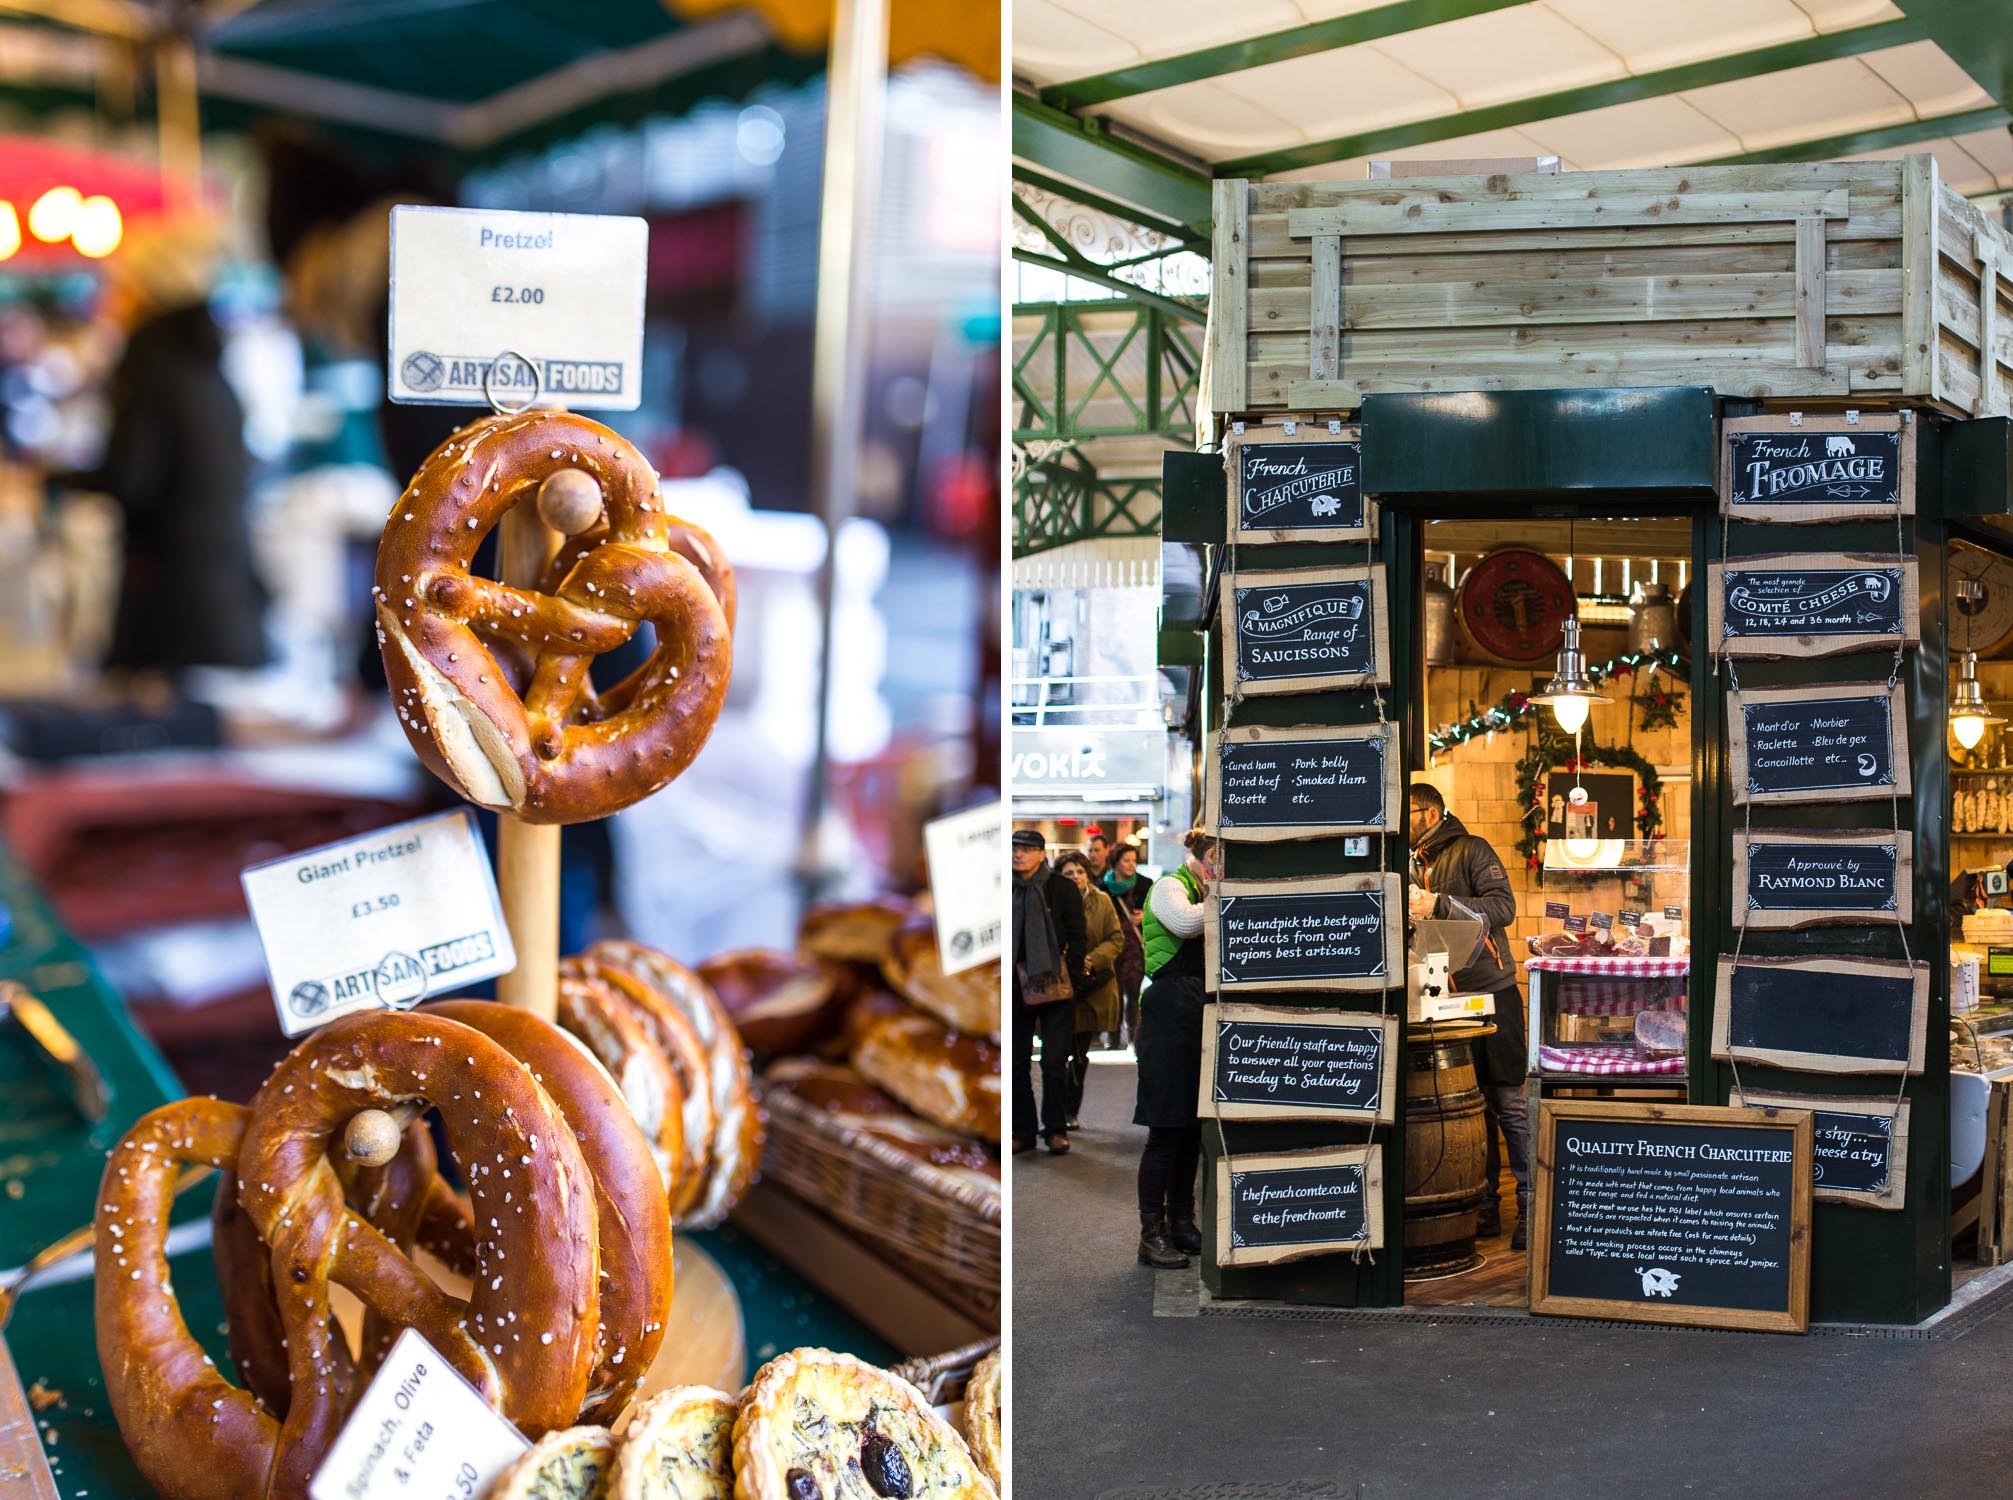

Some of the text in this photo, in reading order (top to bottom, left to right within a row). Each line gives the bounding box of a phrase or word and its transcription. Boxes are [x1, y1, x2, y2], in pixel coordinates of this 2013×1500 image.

[481, 226, 552, 249] Pretzel
[491, 286, 544, 305] £2.00
[549, 365, 620, 391] FOODS
[1752, 438, 1812, 458] French
[1247, 457, 1308, 480] French
[1746, 459, 1884, 500] FROMAGE
[1246, 467, 1352, 513] CHARCUTERIE
[1763, 578, 1806, 587] most grande
[1793, 586, 1803, 594] of
[1738, 582, 1858, 613] COMTÉ CHEESE
[1245, 602, 1348, 632] A MAGNIFIQUE
[1746, 618, 1757, 628] 12,
[1760, 618, 1771, 628] 18,
[1774, 617, 1787, 626] 24
[1810, 616, 1822, 624] 36
[1825, 614, 1851, 624] month
[1303, 624, 1359, 644] Range of
[1252, 647, 1349, 663] SAUCISSONS
[1757, 722, 1779, 732] Mont
[1813, 718, 1849, 728] Morbier
[1757, 739, 1797, 749] Raclette
[1815, 735, 1867, 747] Bleu de gex
[1228, 761, 1276, 770] Cured ham
[1295, 757, 1348, 773] Pork belly
[1757, 756, 1814, 767] Cancoillotte
[1229, 775, 1281, 791] Dried beef
[1296, 775, 1367, 785] Smoked Ham
[1228, 794, 1267, 804] Rosette
[1292, 794, 1314, 804] etc.
[297, 836, 422, 884] Giant Pretzel
[1788, 858, 1860, 871] Approuvé by
[1758, 875, 1885, 889] RAYMOND BLANC
[352, 893, 400, 918] £3.50
[1228, 915, 1379, 935] We handpick the best quality
[1229, 931, 1351, 947] products from our
[425, 933, 492, 974] FOODS
[1229, 945, 1361, 964] regions best artisans
[1229, 1034, 1378, 1060] Our friendly staff are happy
[1228, 1054, 1374, 1072] to answer all your questions
[1227, 1071, 1361, 1094] Tuesday to Saturday
[1567, 1138, 1792, 1163] QUALITY FRENCH CHARCUTERIE
[1815, 1144, 1884, 1167] heese try
[1665, 1170, 1672, 1178] by
[1690, 1171, 1728, 1180] passionate
[1242, 1181, 1358, 1205] thefrenchcomte.co.uk
[1583, 1188, 1596, 1196] free
[1599, 1190, 1618, 1199] range
[1636, 1191, 1648, 1199] fed
[1638, 1182, 1652, 1190] that
[1696, 1185, 1717, 1196] happy
[1720, 1186, 1735, 1194] local
[1736, 1187, 1763, 1196] animals
[1766, 1188, 1780, 1197] who
[1253, 1208, 1346, 1228] @thefrenchcomte
[1568, 1211, 1603, 1219] standards
[1619, 1214, 1652, 1222] respected
[1679, 1217, 1699, 1225] comes
[1711, 1219, 1733, 1230] raising
[1736, 1220, 1746, 1228] the
[1581, 1203, 1597, 1212] pork
[1655, 1205, 1666, 1213] the
[1704, 1209, 1723, 1217] which
[1755, 1212, 1779, 1220] certain
[1567, 1224, 1583, 1232] Most
[1605, 1227, 1632, 1235] products
[1669, 1229, 1681, 1237] free
[1702, 1231, 1712, 1239] for
[1596, 1241, 1623, 1251] smoking
[1627, 1244, 1655, 1252] process
[1695, 1246, 1706, 1254] the
[1709, 1246, 1743, 1259] chimneys
[1706, 1257, 1731, 1266] spruce
[1734, 1258, 1748, 1266] and
[394, 1362, 428, 1410] Olive
[394, 1421, 435, 1485] & Feta
